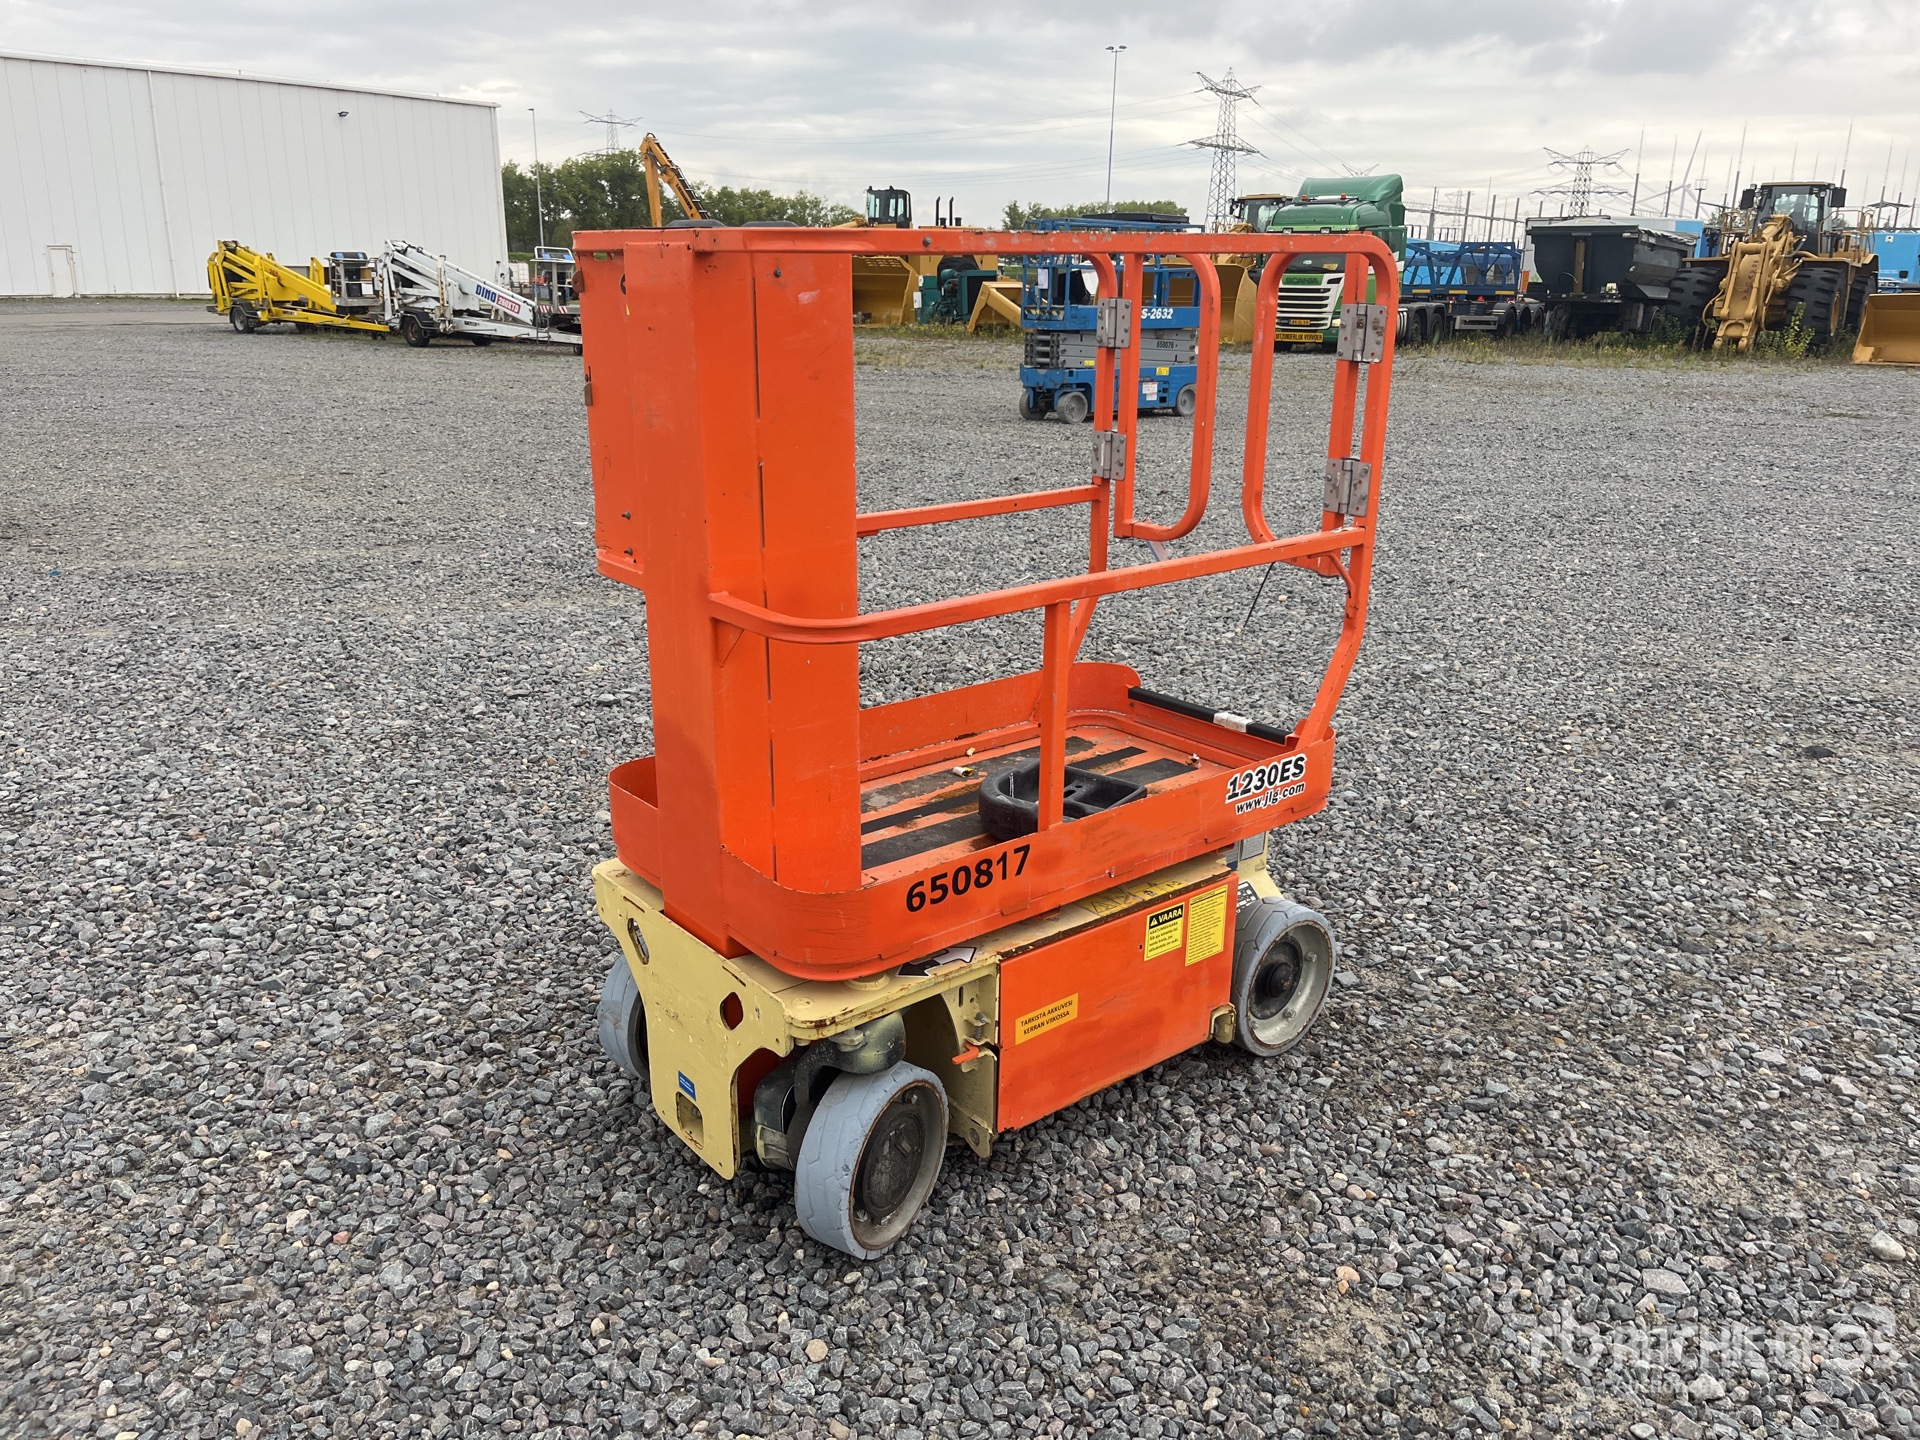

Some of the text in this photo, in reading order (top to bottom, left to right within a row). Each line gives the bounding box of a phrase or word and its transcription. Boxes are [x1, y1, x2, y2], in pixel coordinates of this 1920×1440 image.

[475, 284, 497, 303] DINO
[1285, 277, 1319, 285] SCANIA
[1157, 341, 1174, 349] 650076
[1226, 755, 1306, 802] 1230ES
[1235, 783, 1305, 814] www.jlg.com
[906, 844, 1031, 912] 650817
[1158, 908, 1182, 923] VAARA
[1021, 1000, 1073, 1027] TARKISTA AKKUVESI
[1023, 1010, 1070, 1035] KERRAN VIIKOSSA
